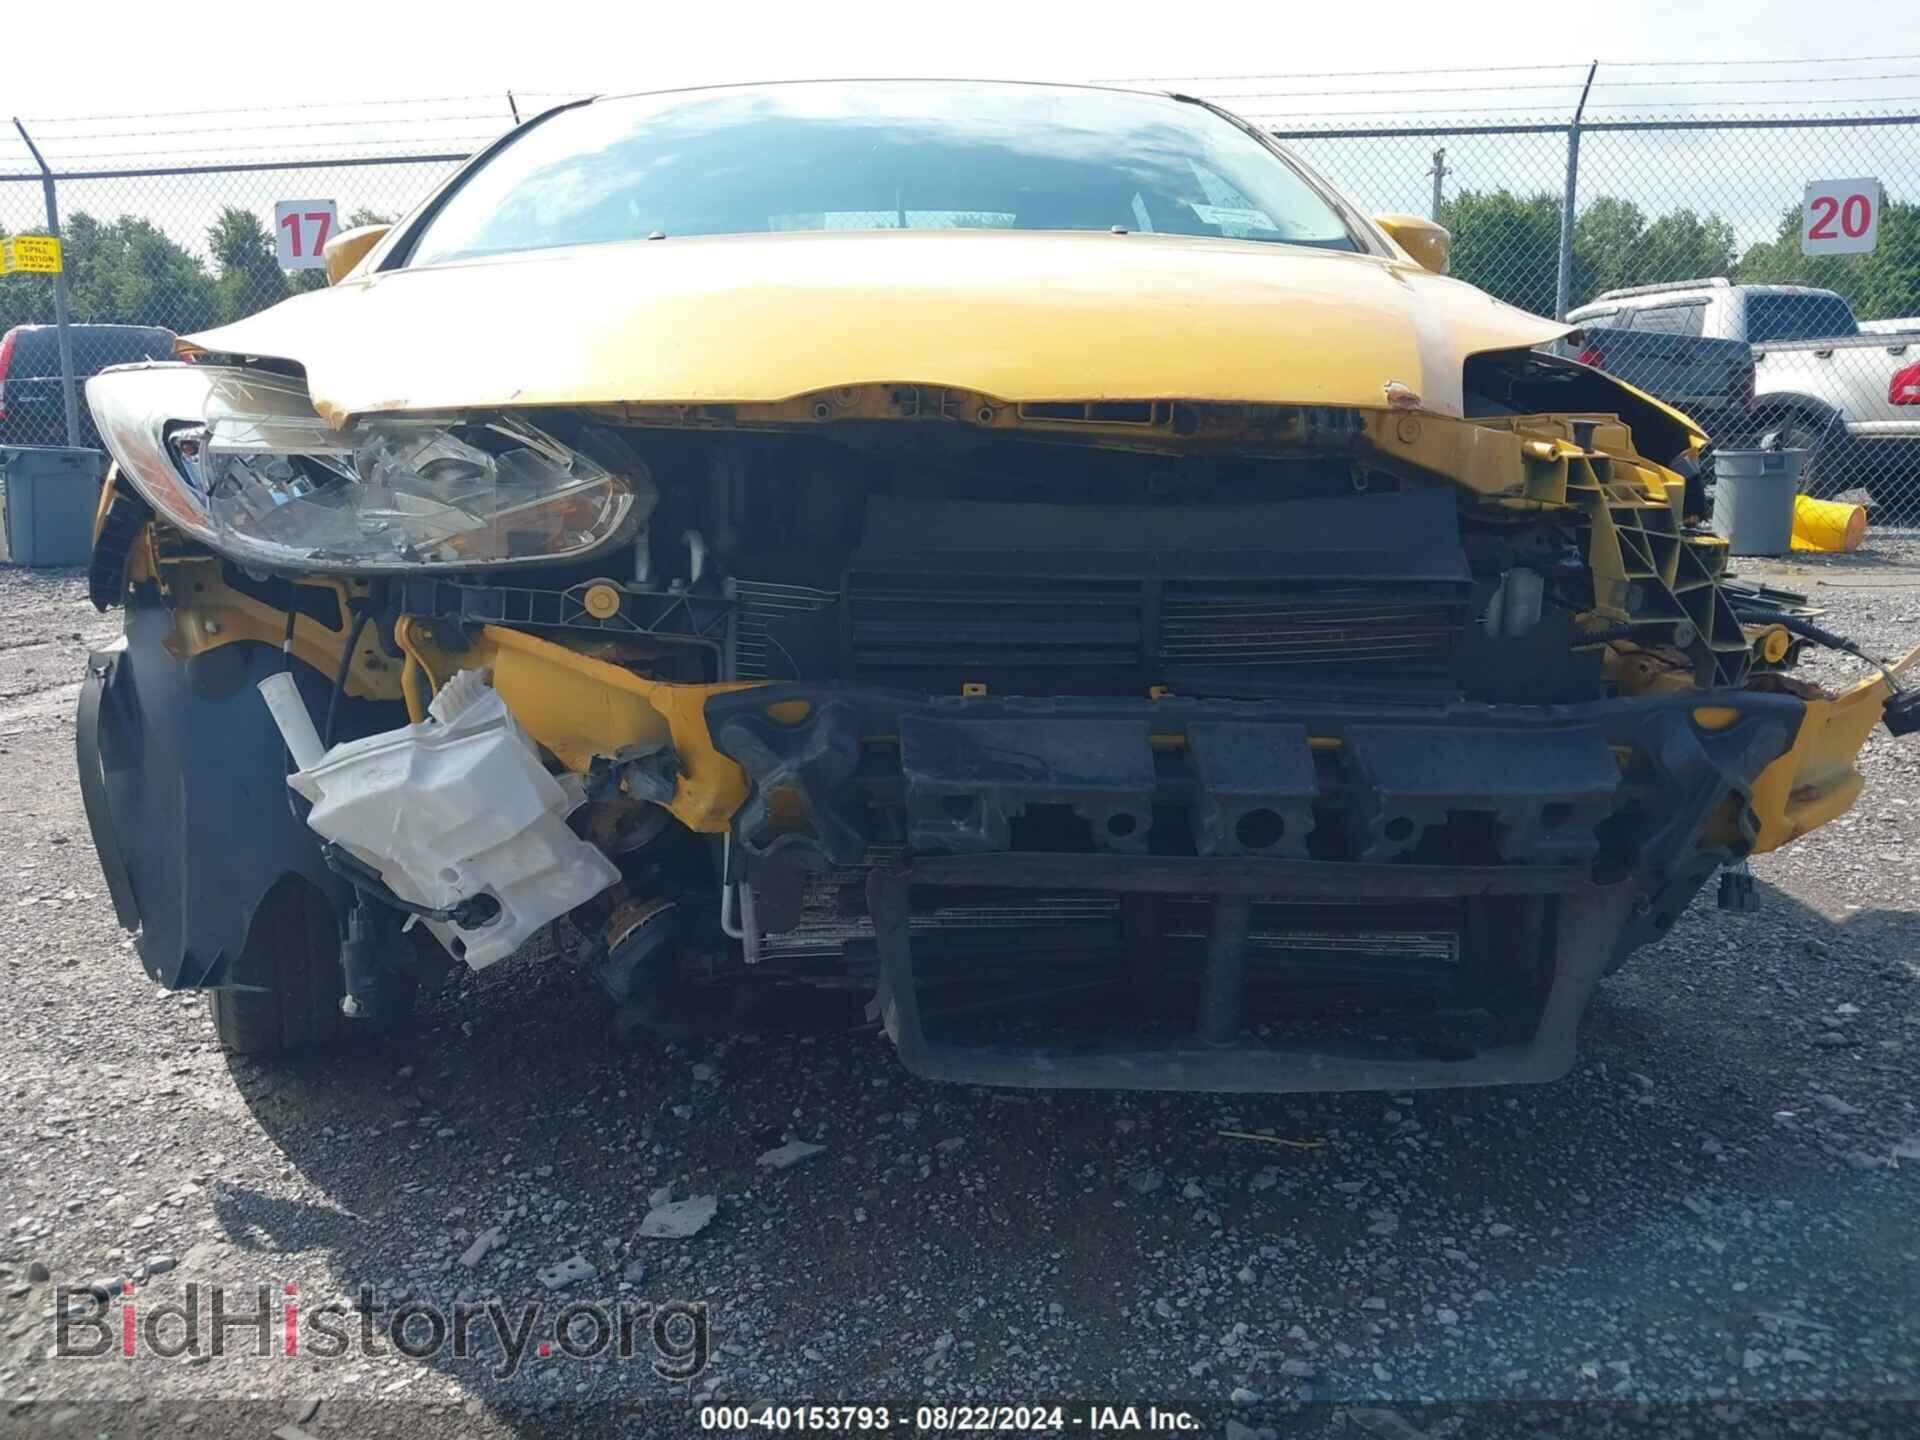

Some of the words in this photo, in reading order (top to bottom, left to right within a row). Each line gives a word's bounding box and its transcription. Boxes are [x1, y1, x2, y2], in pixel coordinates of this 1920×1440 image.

[281, 212, 332, 257] 17
[1807, 194, 1871, 240] 20
[19, 255, 55, 263] STATION
